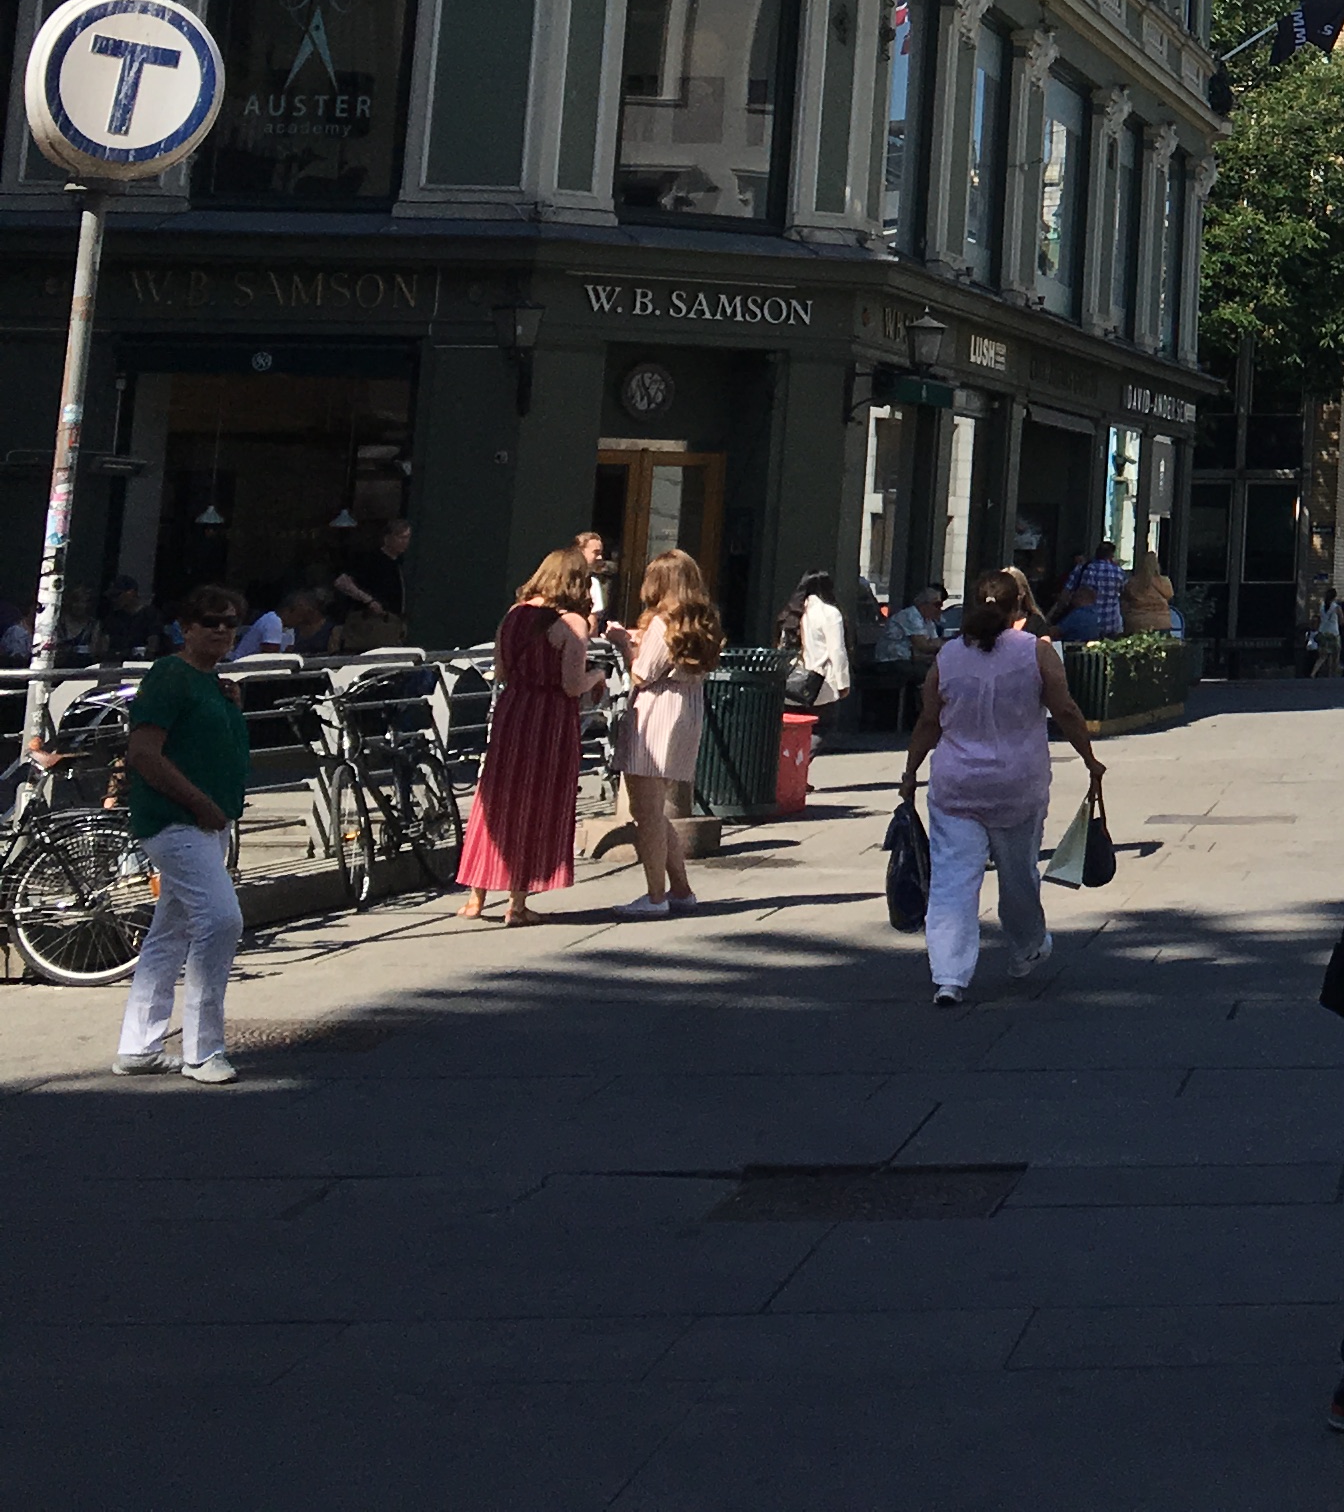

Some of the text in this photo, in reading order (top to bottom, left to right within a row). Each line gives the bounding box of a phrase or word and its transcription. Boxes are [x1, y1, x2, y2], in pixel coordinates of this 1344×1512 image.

[89, 33, 182, 137] T
[243, 93, 372, 118] AUSTER
[263, 121, 352, 138] academy
[232, 271, 420, 309] SAMSON
[584, 284, 814, 325] W. B. SAMSON
[970, 334, 996, 368] LUSH
